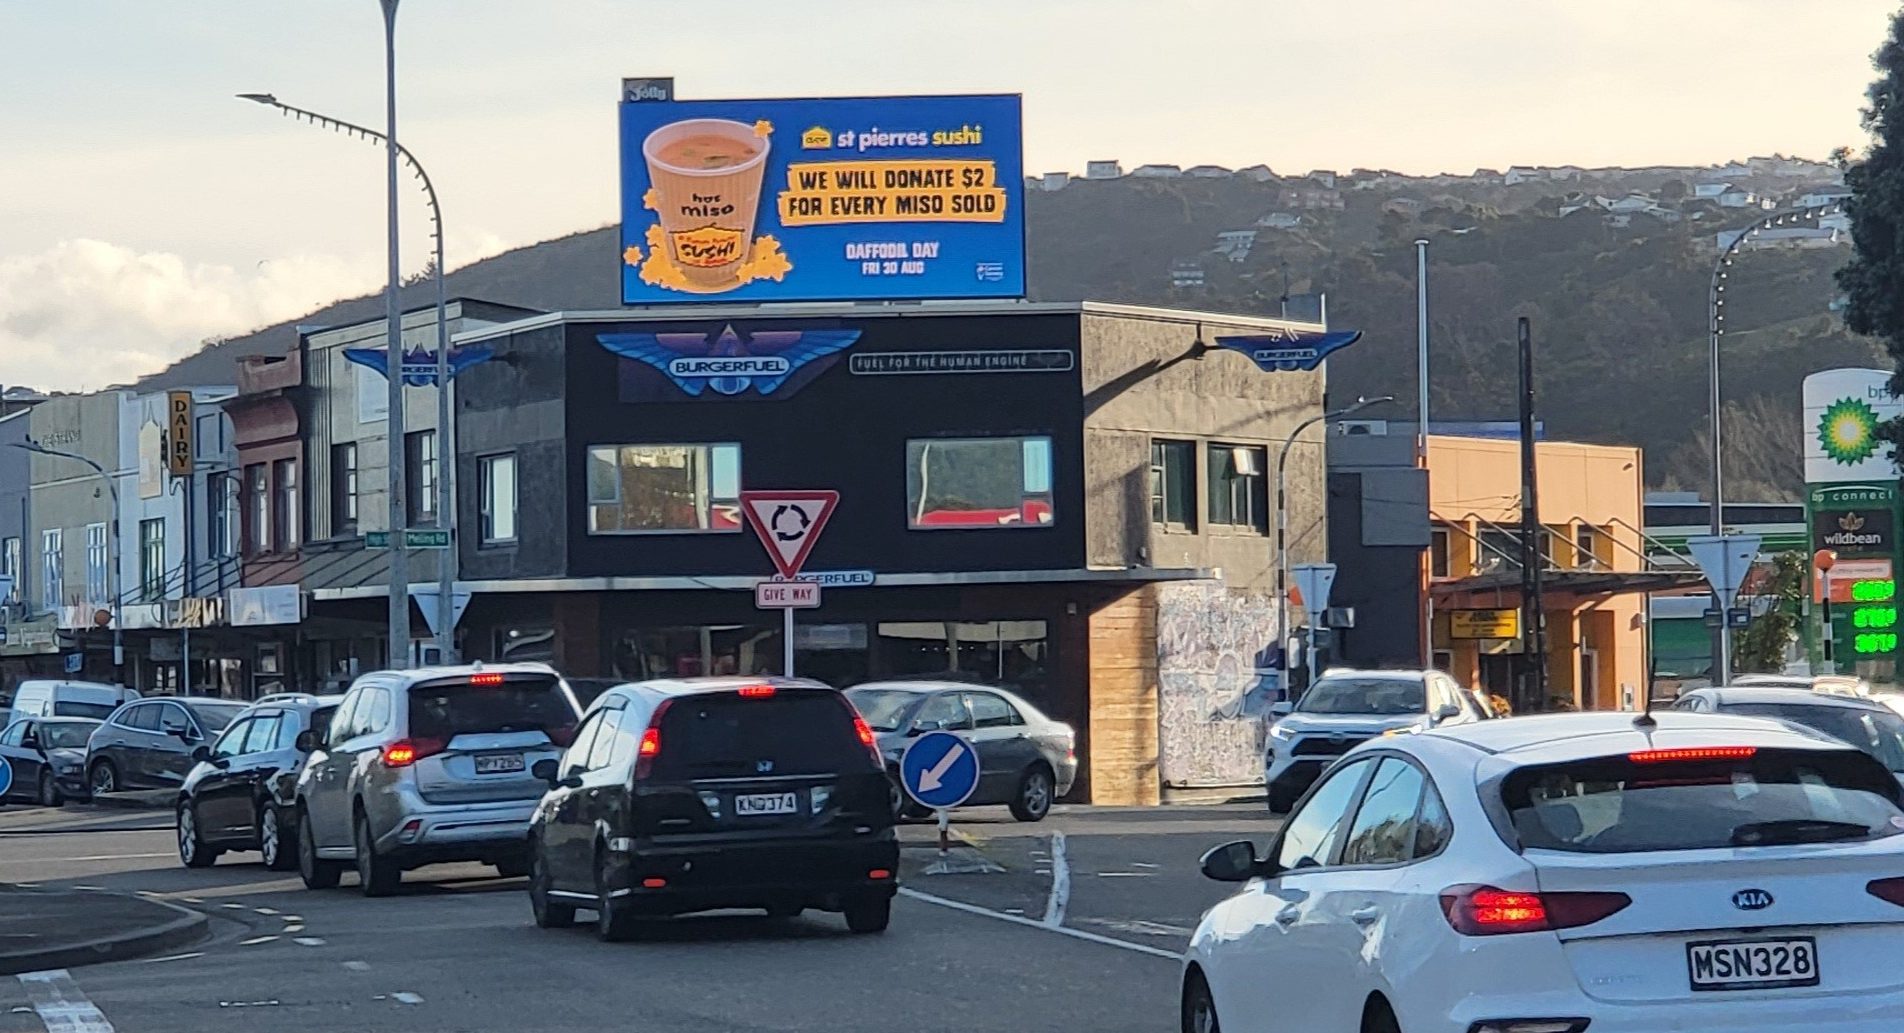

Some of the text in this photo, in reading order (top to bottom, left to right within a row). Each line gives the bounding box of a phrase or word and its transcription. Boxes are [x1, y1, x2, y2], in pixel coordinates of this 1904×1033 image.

[837, 131, 854, 148] st
[859, 127, 928, 152] pierres
[932, 125, 982, 146] sushi
[799, 166, 984, 190] WE WILL DONATE $2
[681, 204, 734, 217] miso
[789, 194, 996, 216] FOR EVERY MISO SOLD
[681, 241, 735, 258] SUSHI
[846, 242, 939, 259] DAFFODIL DAY
[862, 261, 924, 275] FRI 30 AUG
[676, 360, 785, 373] BURGERFUEL
[858, 355, 1027, 369] FUEL FOR THE HUMAN ENGINE
[175, 400, 188, 467] DAIRY
[1832, 489, 1893, 501] connect
[1823, 532, 1882, 545] wildbean
[764, 588, 812, 601] GIVE WAY
[1739, 892, 1769, 906] KIA
[1693, 945, 1810, 979] MSN328
